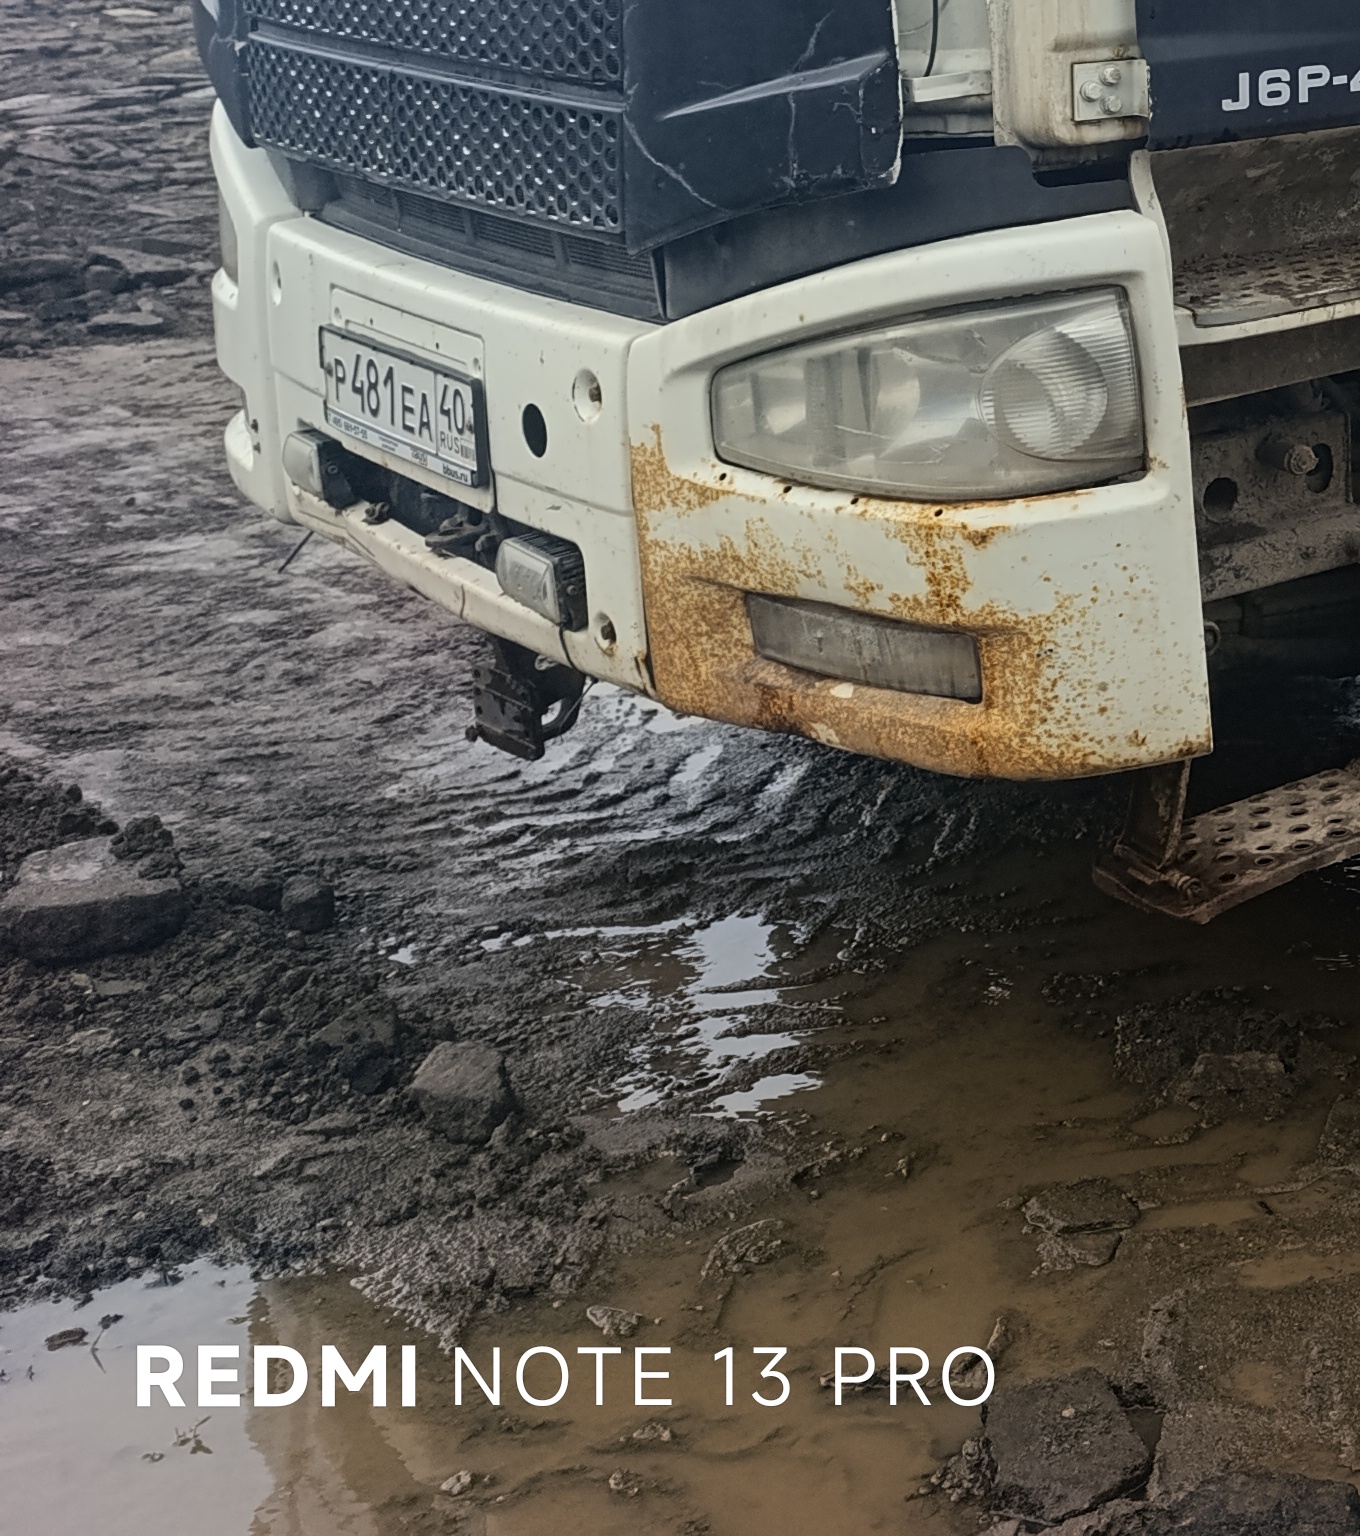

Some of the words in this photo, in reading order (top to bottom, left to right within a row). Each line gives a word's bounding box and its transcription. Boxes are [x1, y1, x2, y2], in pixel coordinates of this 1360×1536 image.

[439, 383, 466, 436] 40
[440, 430, 461, 455] RUS
[442, 463, 468, 483] bbus.ru
